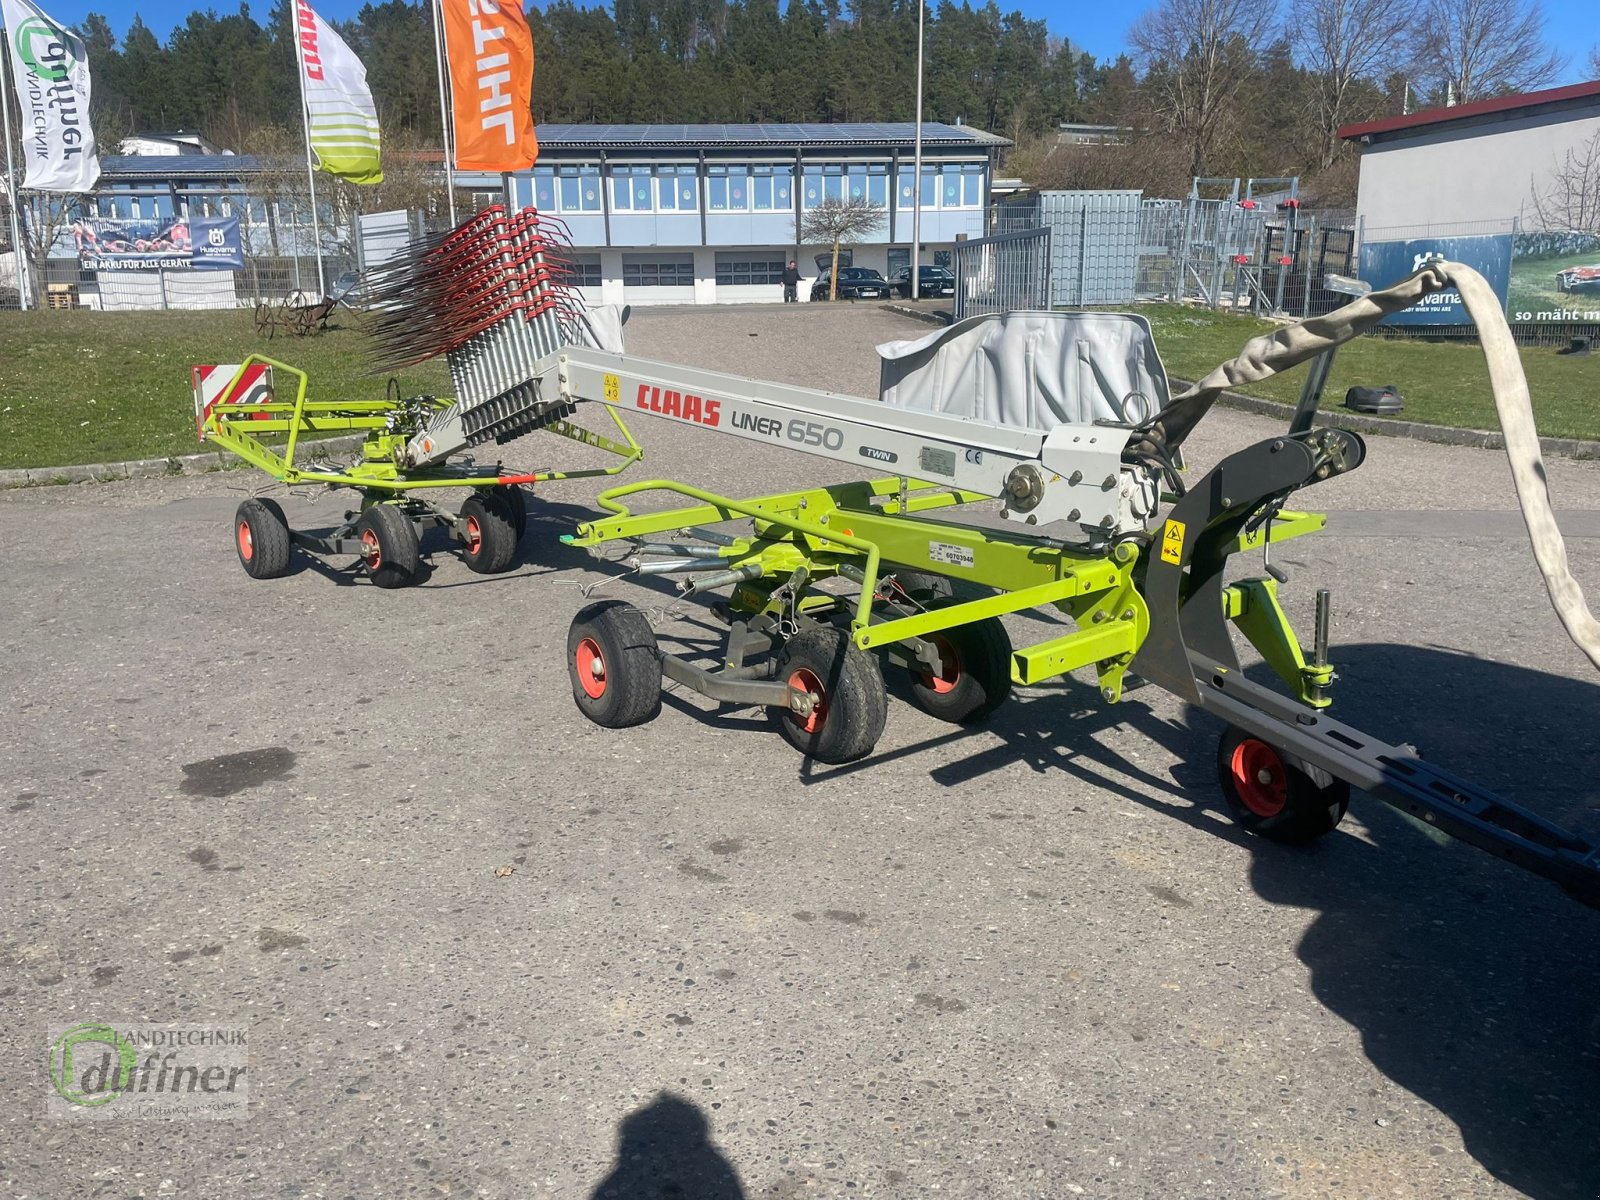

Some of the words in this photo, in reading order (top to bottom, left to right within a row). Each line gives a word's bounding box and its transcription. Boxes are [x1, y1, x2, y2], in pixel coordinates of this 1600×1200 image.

[84, 260, 98, 269] EIN
[99, 260, 121, 270] AKKU
[122, 258, 140, 269] FÜR
[141, 259, 159, 269] ALLE
[160, 258, 191, 268] GERÄTE
[1515, 311, 1532, 321] so
[1536, 308, 1579, 321] mäht
[636, 383, 721, 427] CLAAS
[731, 410, 783, 438] LINER
[786, 418, 845, 451] 650
[866, 448, 892, 461] TWIN
